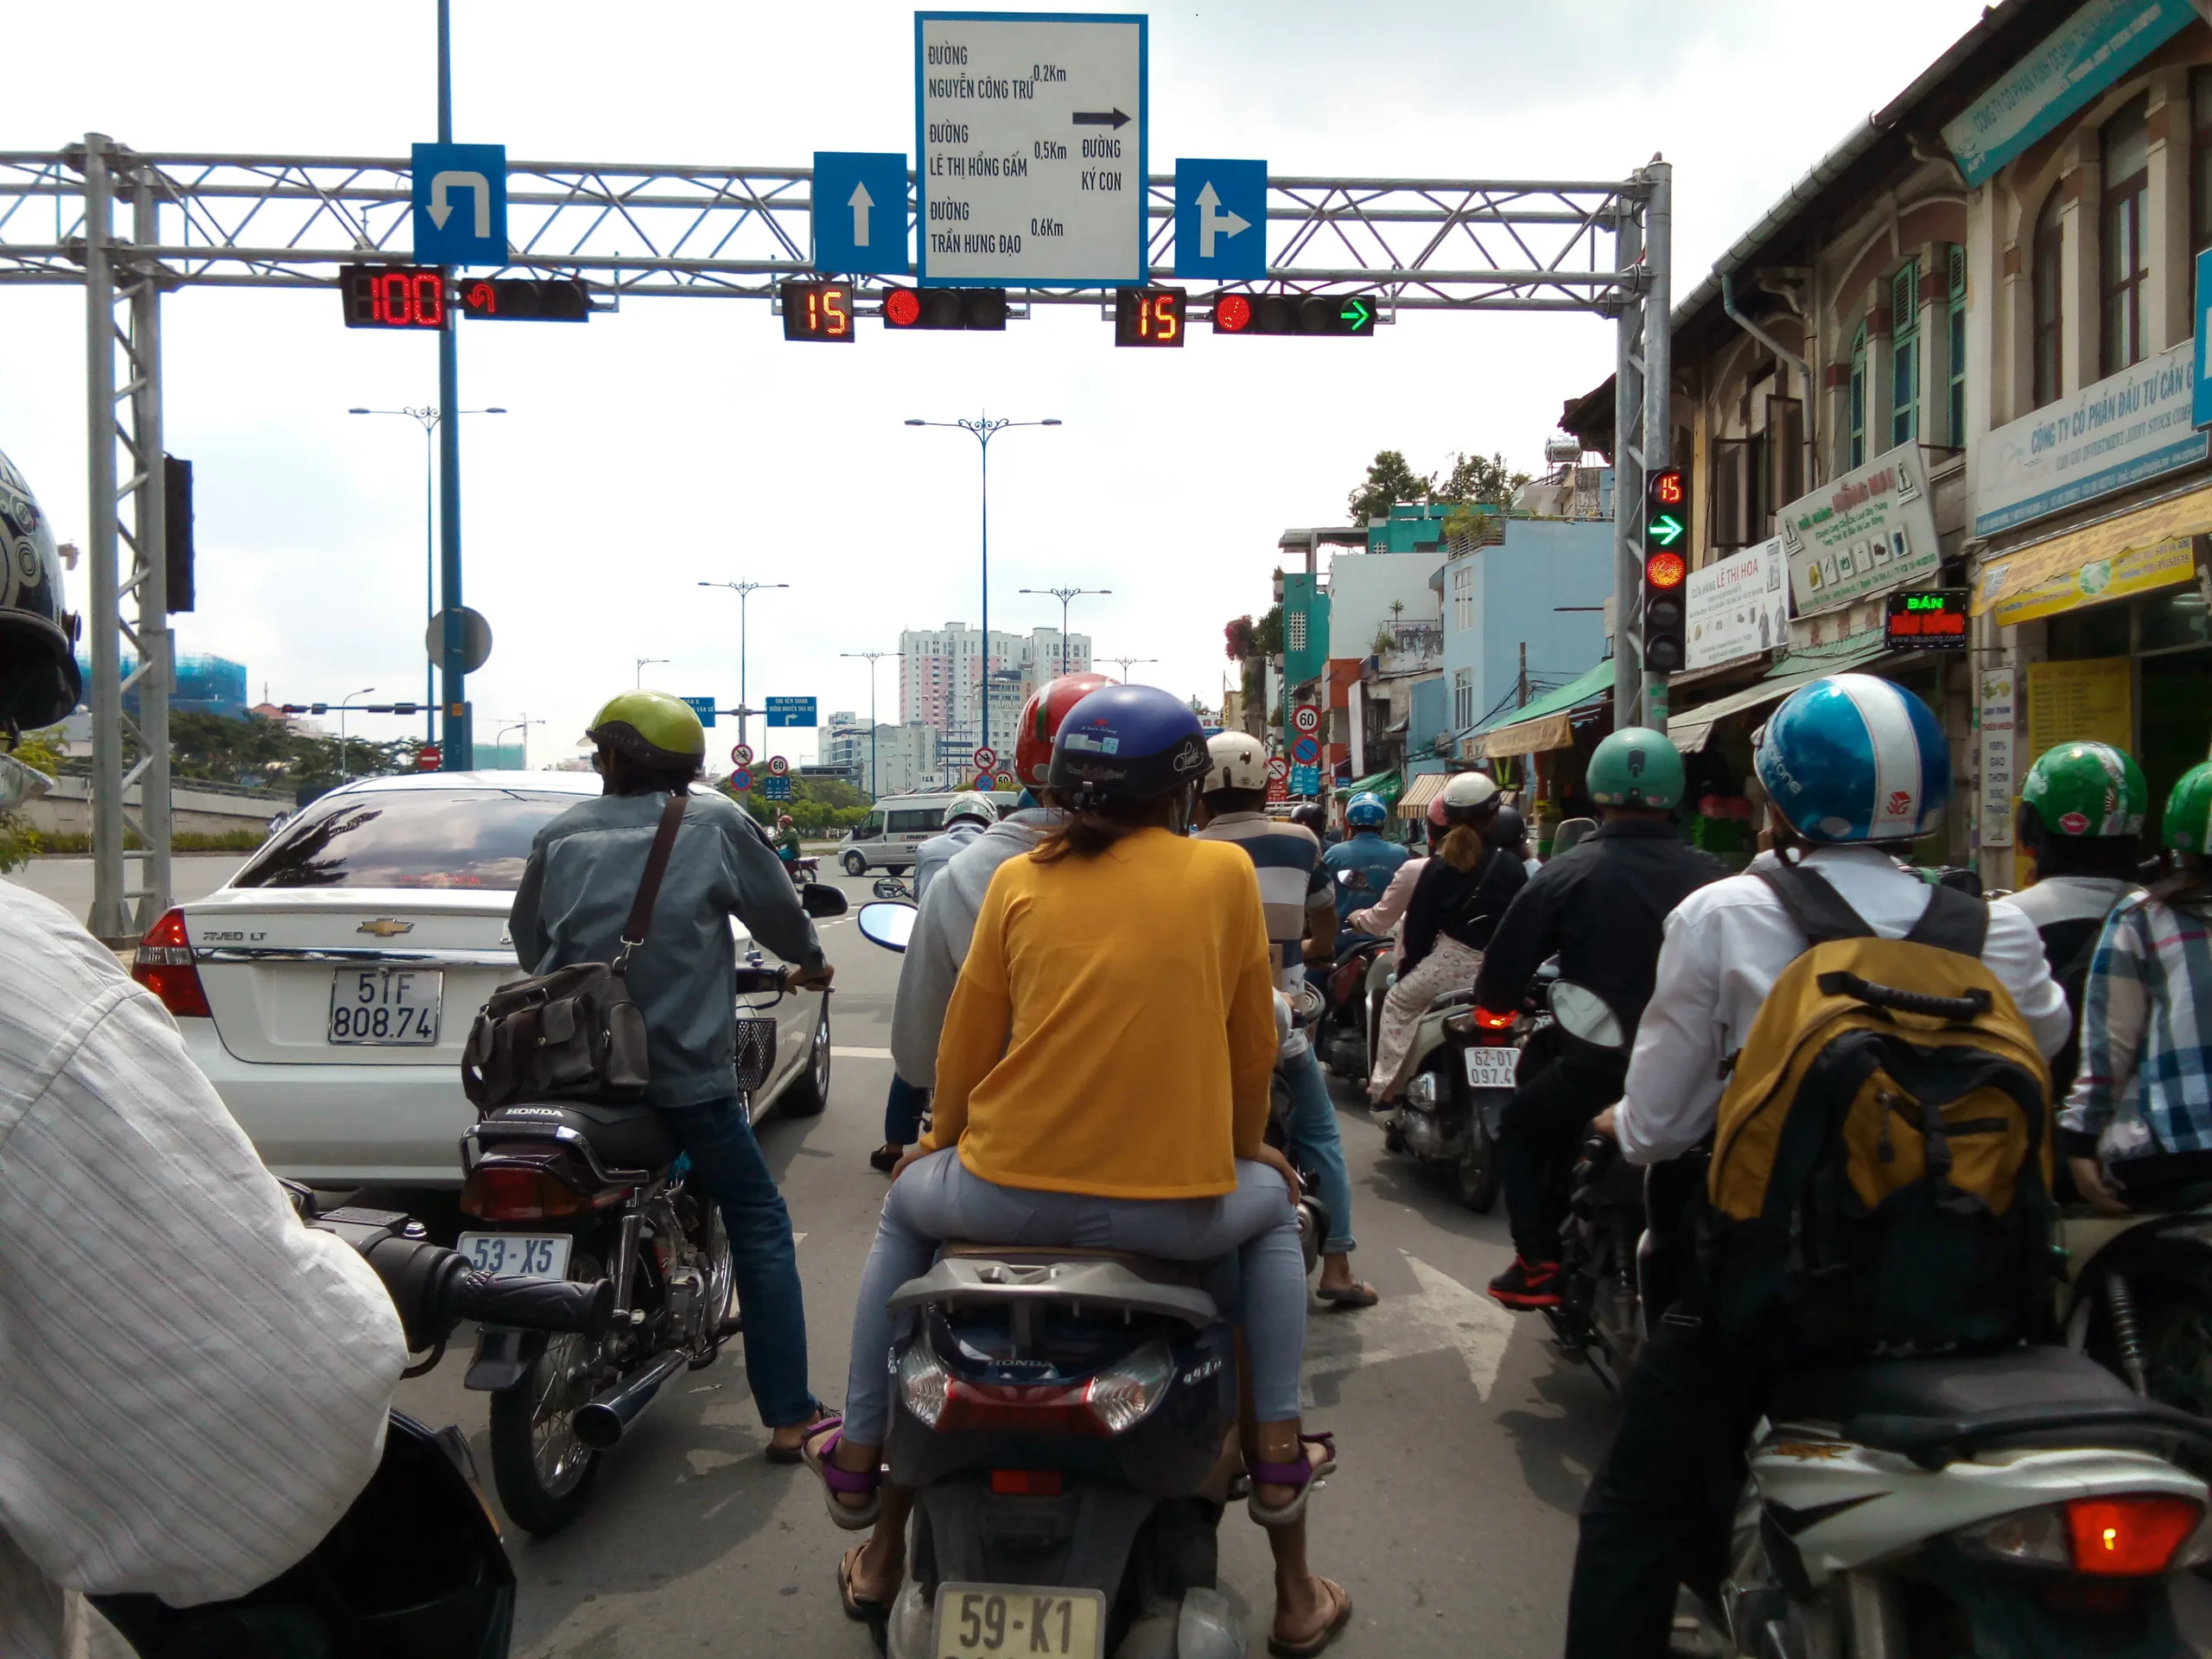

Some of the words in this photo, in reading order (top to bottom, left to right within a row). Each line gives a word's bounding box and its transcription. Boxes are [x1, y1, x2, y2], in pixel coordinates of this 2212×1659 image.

[928, 41, 968, 66] ĐƯỜNG
[929, 73, 975, 99] NGUYỄN
[978, 75, 1008, 99] CÔNG
[1012, 75, 1035, 99] TRỨ
[929, 118, 969, 143] ĐƯỜNG
[1082, 134, 1122, 158] ĐƯỜNG
[930, 153, 944, 176] LÊ
[947, 156, 965, 180] THỊ
[968, 149, 999, 177] HỒNG
[1002, 150, 1027, 177] GẤM
[1082, 166, 1096, 191] KÝ
[1099, 172, 1122, 191] CON
[930, 196, 969, 221] ĐƯỜNG
[931, 227, 961, 253] TRẦN
[964, 232, 995, 254] HƯNG
[999, 234, 1022, 257] ĐẠO
[371, 273, 442, 324] 100
[809, 290, 843, 334] 15
[1139, 295, 1177, 339] 15
[2057, 416, 2070, 442] TY
[1662, 475, 1681, 502] 15
[1741, 558, 1759, 580] HOA
[1907, 595, 1944, 609] BÁN
[1299, 713, 1315, 728] 60
[773, 760, 784, 770] 60
[203, 931, 244, 942] AVEO
[251, 931, 267, 942] LT
[358, 972, 416, 1005] 51F
[333, 1006, 432, 1039] 808.74
[1471, 1068, 1511, 1084] 097.4
[505, 1108, 564, 1117] HONDA
[473, 1238, 554, 1274] 53-X5
[958, 1593, 1072, 1655] 59-K1
